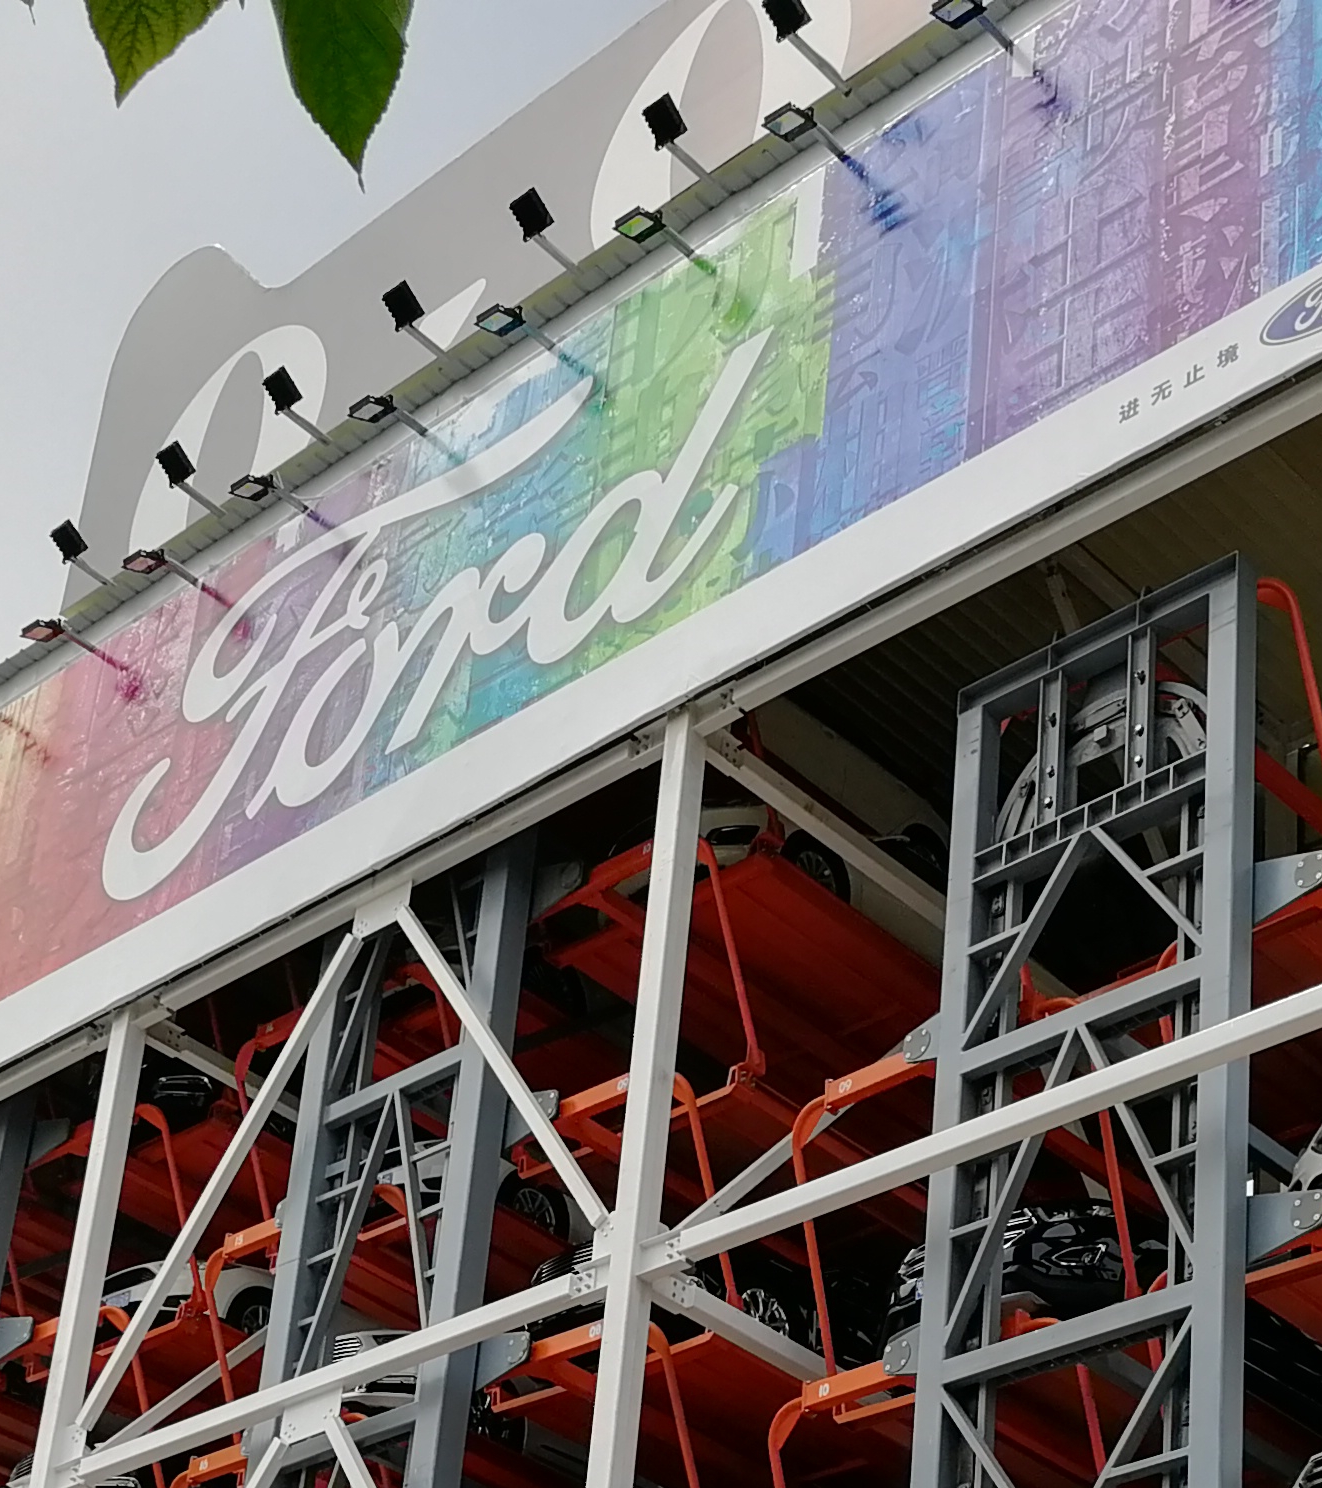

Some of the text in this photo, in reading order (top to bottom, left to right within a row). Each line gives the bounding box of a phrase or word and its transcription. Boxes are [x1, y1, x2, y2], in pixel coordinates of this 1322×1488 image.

[1118, 342, 1240, 424] 进无止境
[102, 325, 774, 900] Ford
[838, 1078, 852, 1094] 09
[818, 1383, 830, 1398] 10
